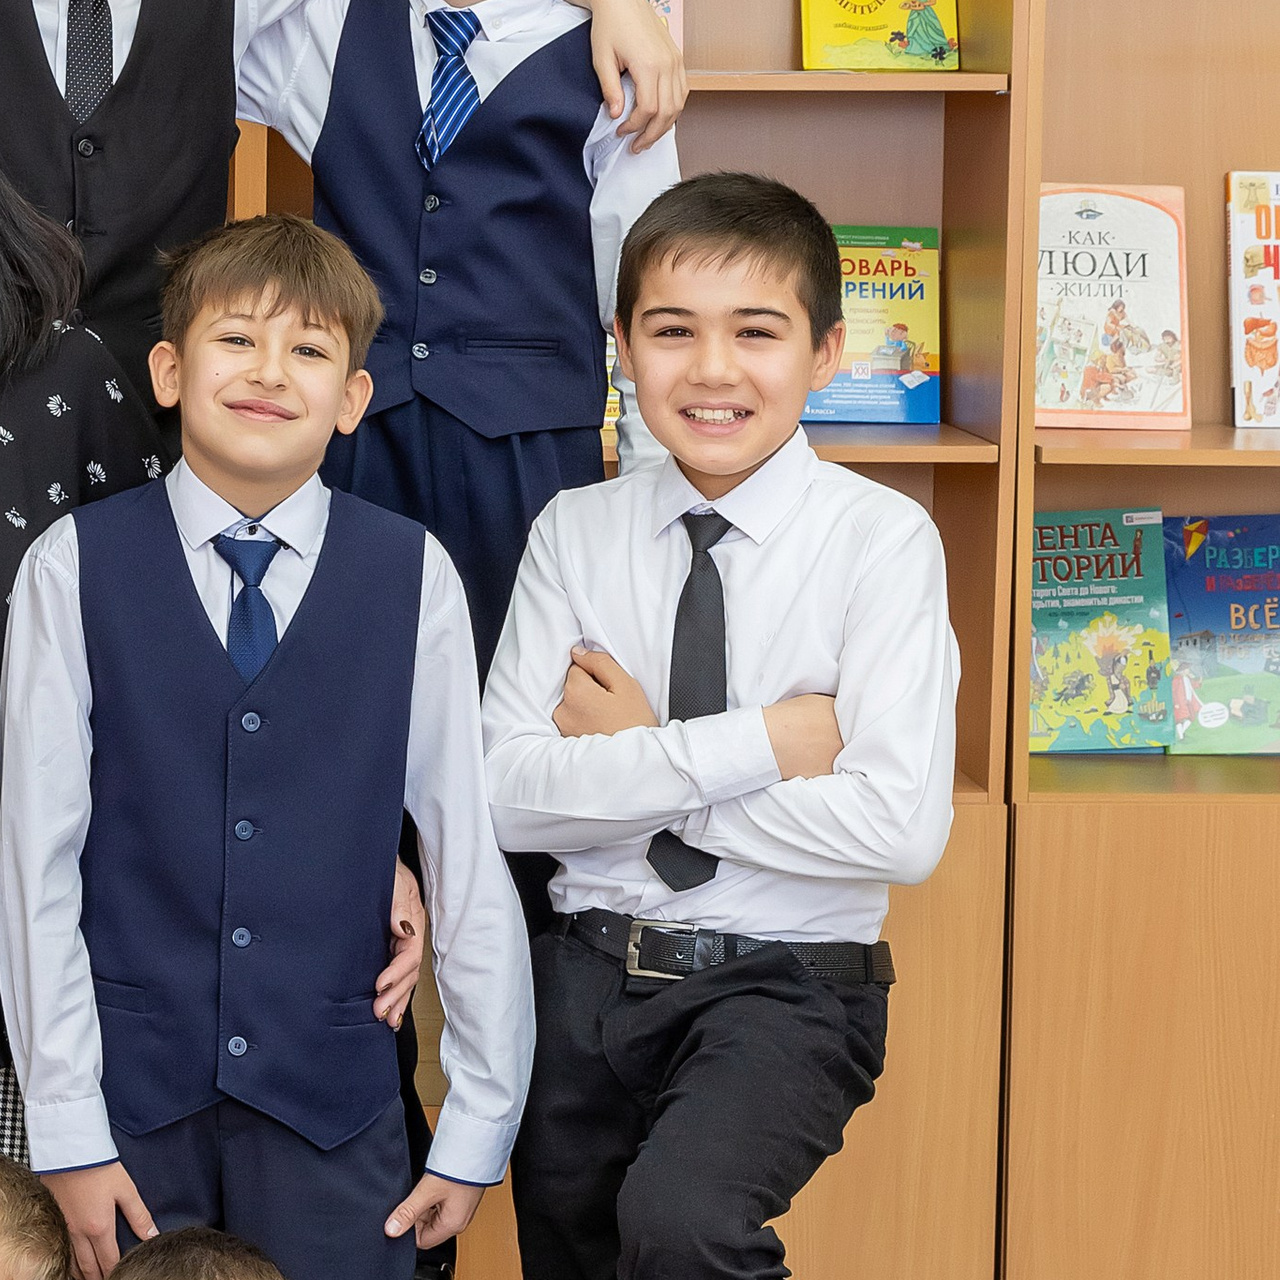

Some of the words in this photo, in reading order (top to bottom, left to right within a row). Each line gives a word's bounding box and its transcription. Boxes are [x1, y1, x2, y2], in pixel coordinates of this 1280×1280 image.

[1068, 230, 1112, 246] КАК
[840, 258, 916, 277] ОВАРЬ
[845, 280, 924, 300] РЕНИЙ
[1056, 282, 1124, 298] ЖИЛИ
[1034, 522, 1121, 553] ЕНТА
[1032, 552, 1144, 584] ТОРИИ
[1230, 597, 1280, 630] ВСЁ
